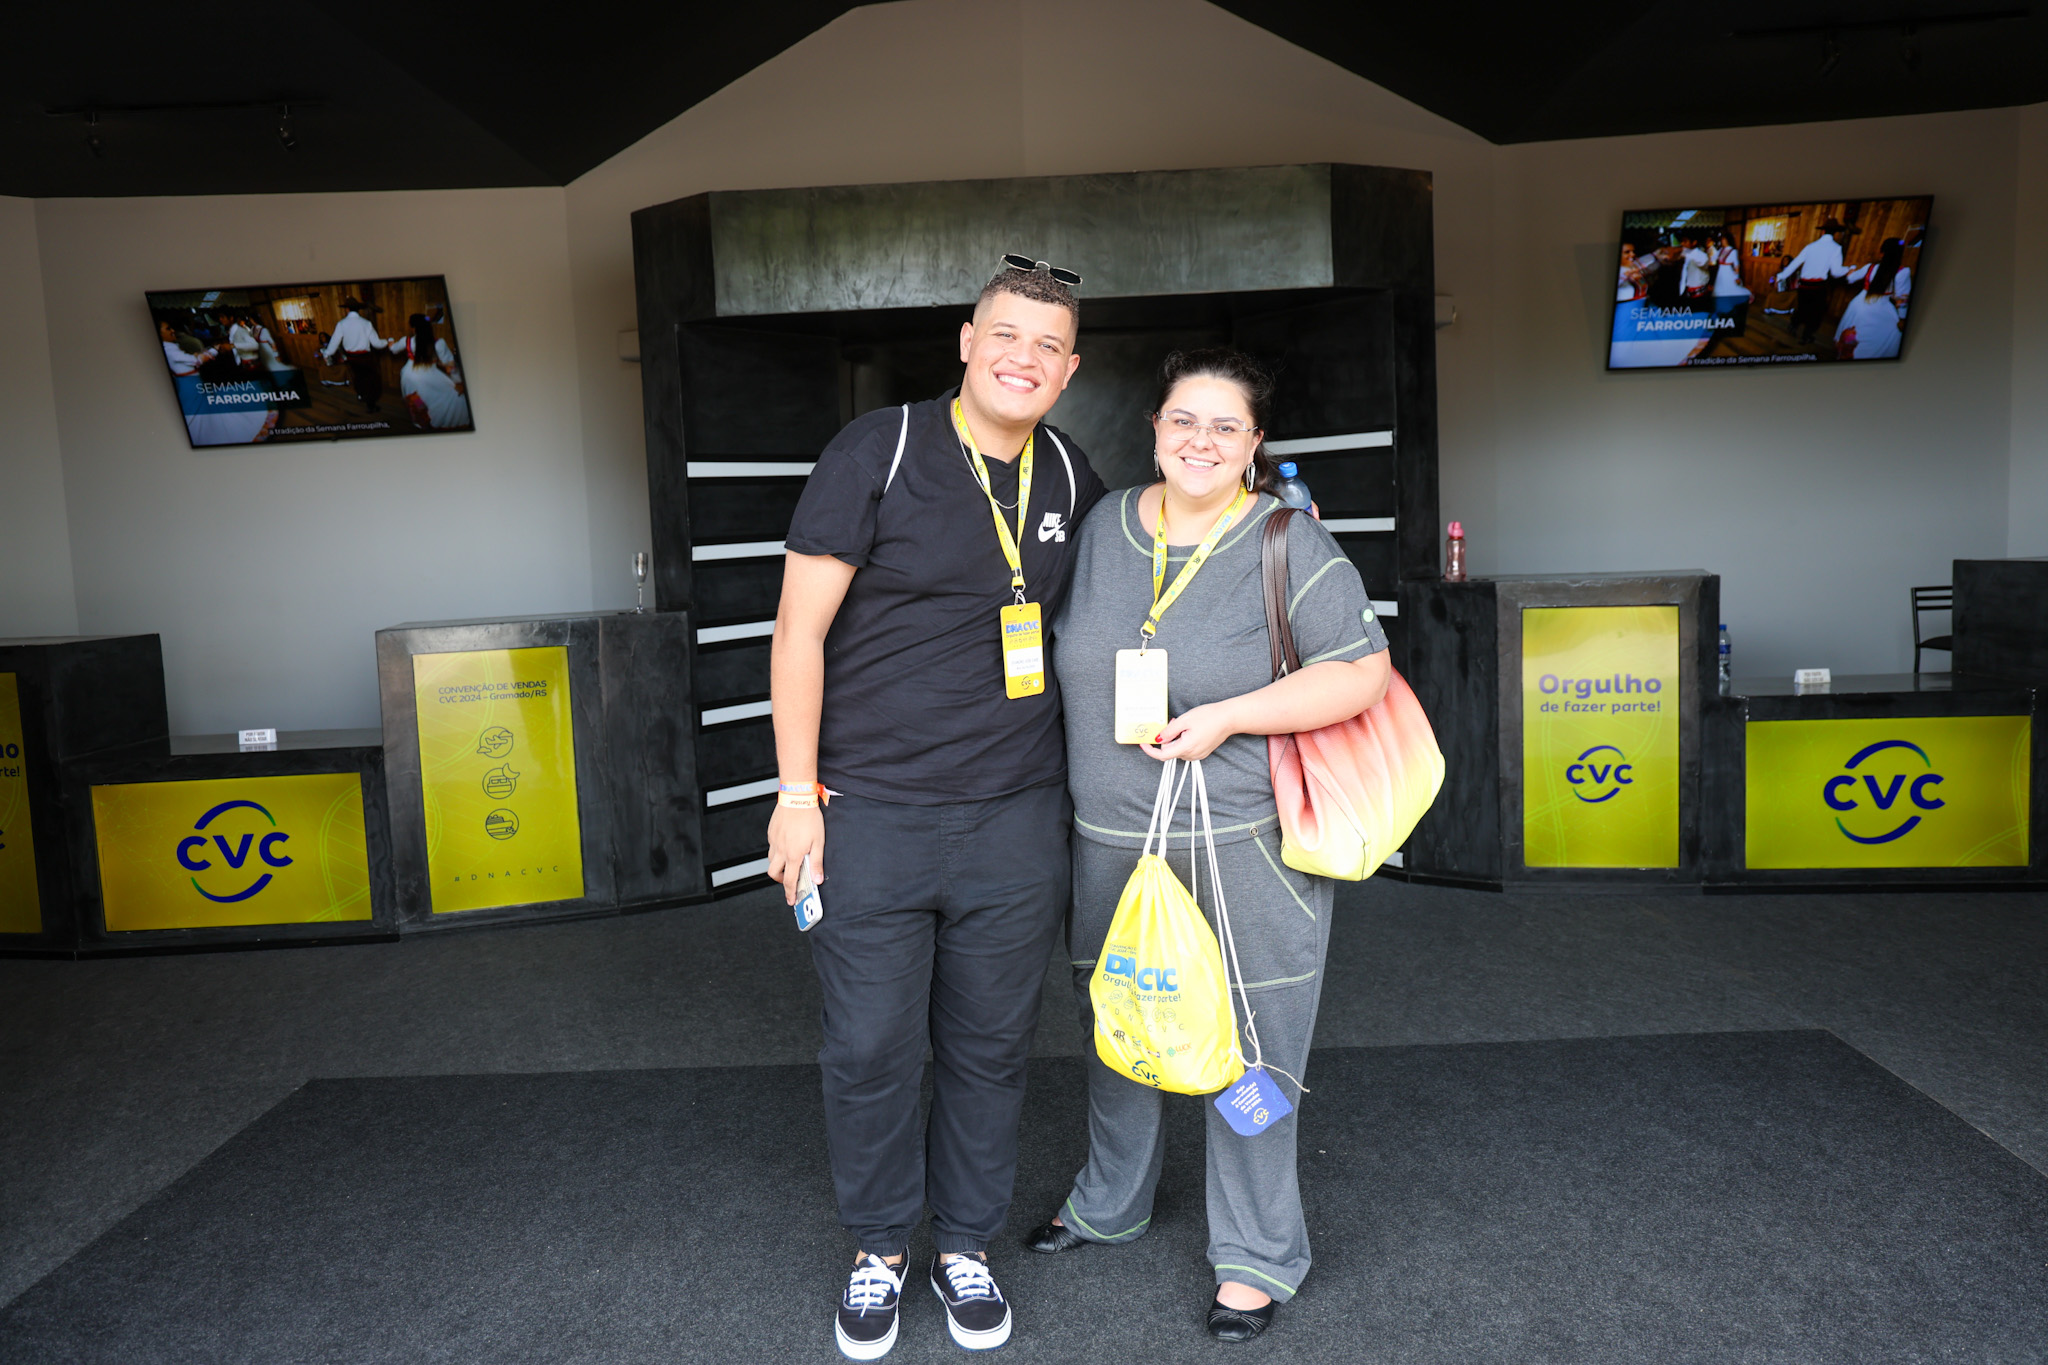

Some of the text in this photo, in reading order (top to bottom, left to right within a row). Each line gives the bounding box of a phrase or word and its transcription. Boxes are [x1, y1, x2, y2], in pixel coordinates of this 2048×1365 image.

[1630, 306, 1693, 320] SEMANA
[1636, 317, 1735, 331] FARROUPILHA
[1694, 356, 1725, 366] tradição
[1726, 356, 1736, 364] da
[1738, 355, 1770, 363] Semana
[196, 380, 256, 394] SEMANA
[207, 390, 300, 405] FARROUPILHA
[275, 426, 305, 435] tradição
[316, 424, 346, 432] Semana
[1042, 512, 1062, 528] NIKE
[1055, 530, 1065, 542] SB
[438, 683, 494, 694] CONVENÇÃO
[511, 680, 547, 689] VENDAS
[1538, 674, 1662, 699] Orgulho
[438, 696, 457, 704] CVC
[459, 694, 481, 702] 2024
[490, 689, 547, 700] Gramado/RS
[1540, 700, 1661, 715] de fazer parte!
[1566, 764, 1634, 784] CVC
[1823, 773, 1946, 811] CVC
[176, 832, 294, 871] CVC
[1132, 1066, 1162, 1085] CVC
[1253, 1108, 1269, 1123] CVC
